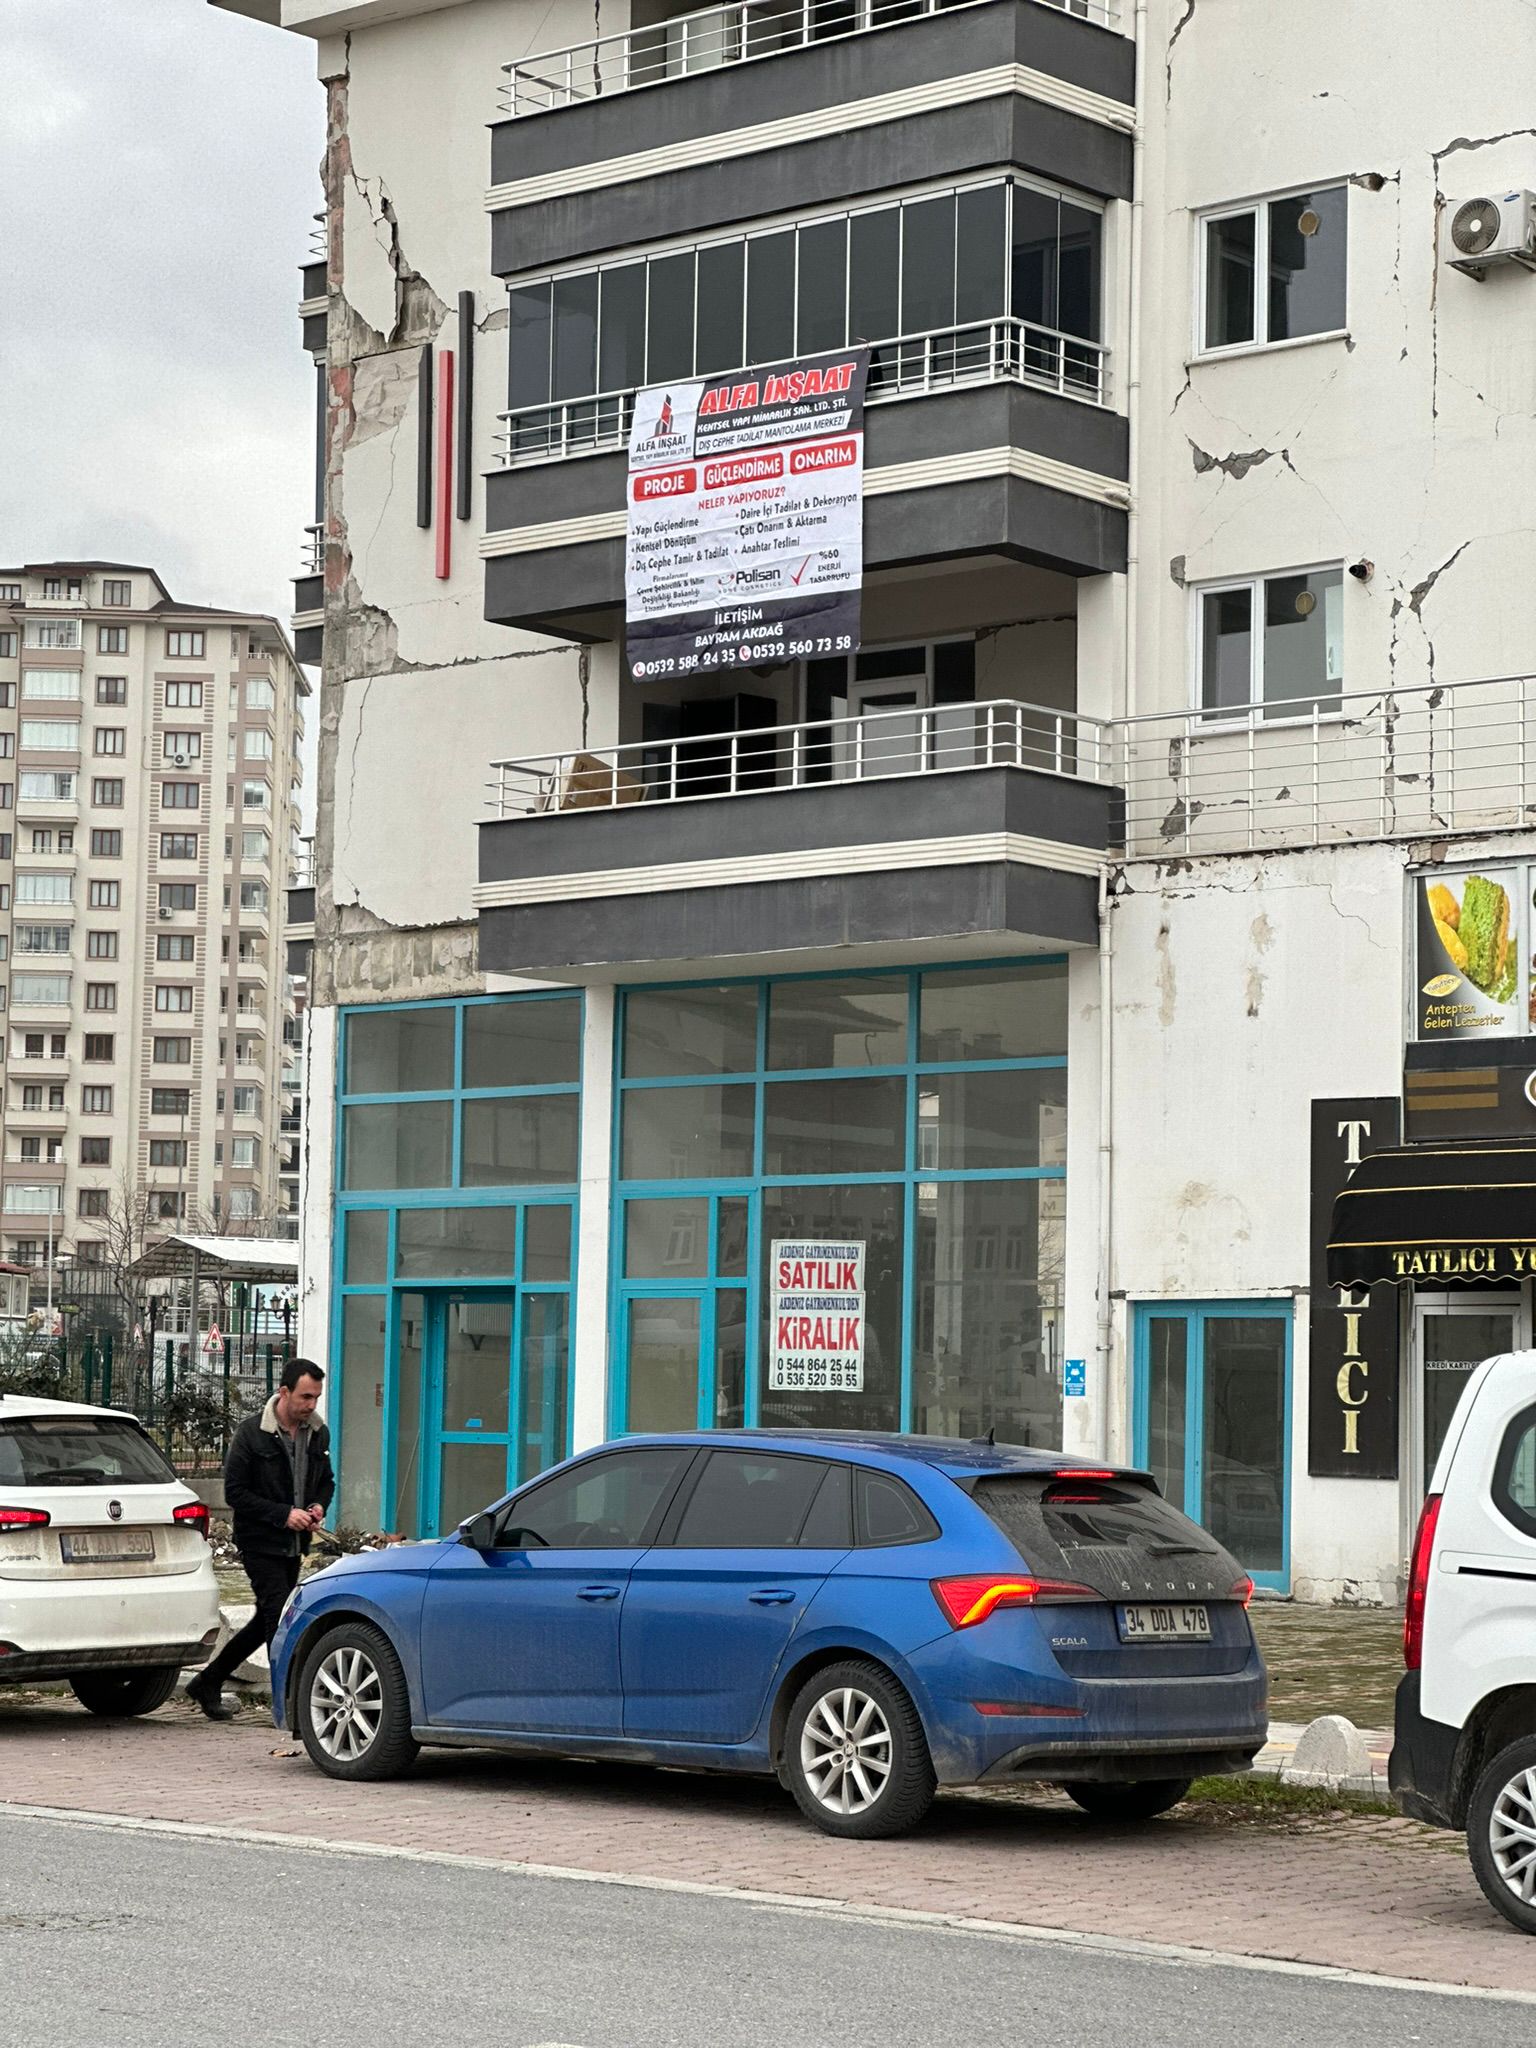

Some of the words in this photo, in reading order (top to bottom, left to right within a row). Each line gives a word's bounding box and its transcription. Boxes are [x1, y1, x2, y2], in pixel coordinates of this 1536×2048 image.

[699, 382, 759, 416] ALFA
[762, 362, 857, 404] İNŞAAT
[697, 420, 730, 433] KENTSEL
[732, 415, 751, 427] YAPI
[752, 407, 791, 423] MİMARLIK
[793, 405, 812, 416] SAN.
[814, 401, 831, 412] LTD.
[833, 395, 847, 411] ŞTİ.
[636, 440, 656, 453] ALFA
[658, 434, 687, 449] İNŞAAT
[699, 437, 711, 451] DIŞ
[712, 434, 735, 448] CEPHE
[736, 429, 763, 443] TADİLAT
[764, 423, 812, 439] MANTOLAMA
[813, 415, 846, 431] MERKEZİ
[795, 445, 852, 470] ONARIM
[706, 457, 780, 486] GÜÇLENDİRME
[644, 474, 685, 496] PROJE
[699, 496, 725, 510] NELER
[727, 486, 786, 505] YAPIYORUZ?
[740, 506, 761, 519] Daire
[763, 502, 772, 518] İçi
[775, 499, 801, 513] Tadilat
[804, 498, 810, 506] &
[813, 493, 857, 508] Dekorasyon
[635, 525, 652, 538] Yapı
[654, 517, 699, 534] Güçlendirme
[740, 523, 755, 539] Çatı
[757, 520, 784, 533] Onarım
[787, 518, 793, 528] &
[795, 514, 827, 528] Aktarma
[664, 534, 697, 549] Dönüşüm
[741, 541, 771, 555] Anahtar
[773, 536, 800, 549] Teslimi
[635, 560, 646, 572] Dış
[648, 556, 671, 571] Cephe
[674, 552, 694, 565] Tamir
[696, 551, 702, 561] &
[705, 546, 728, 559] Tadilat
[819, 549, 839, 559] %60
[736, 569, 780, 584] Polisan
[817, 561, 841, 572] ENERJİ
[810, 572, 850, 584] TASARRUFU
[714, 606, 763, 625] İLETİŞİM
[695, 630, 740, 647] BAYRAM
[742, 622, 783, 640] AKDAĞ
[646, 658, 675, 674] 0532
[678, 654, 699, 670] 588
[703, 652, 718, 665] 24
[721, 649, 735, 662] 35
[752, 642, 785, 658] 0532
[789, 639, 813, 655] 560
[816, 637, 832, 652] 73
[835, 635, 851, 649] 58
[1426, 1003, 1476, 1017] Antepten
[1424, 1016, 1452, 1029] Gelen
[1455, 1013, 1505, 1027] Lezzetler
[1392, 1247, 1496, 1275] TATLICI
[779, 1261, 857, 1290] SATILIK
[777, 1358, 783, 1371] 0
[786, 1358, 804, 1371] 544
[807, 1358, 827, 1371] 864
[830, 1358, 842, 1371] 25
[844, 1359, 857, 1372] 44
[1449, 1361, 1470, 1369] KARTI
[777, 1373, 783, 1385] 0
[786, 1373, 804, 1385] 536
[807, 1373, 827, 1386] 520
[830, 1373, 842, 1386] 59
[845, 1374, 857, 1387] 55
[73, 1536, 89, 1554] 44
[128, 1534, 151, 1552] 550
[1126, 1608, 1144, 1632] 34
[1150, 1607, 1177, 1632] DDA
[1182, 1607, 1207, 1631] 478
[1052, 1637, 1088, 1646] SCALA
